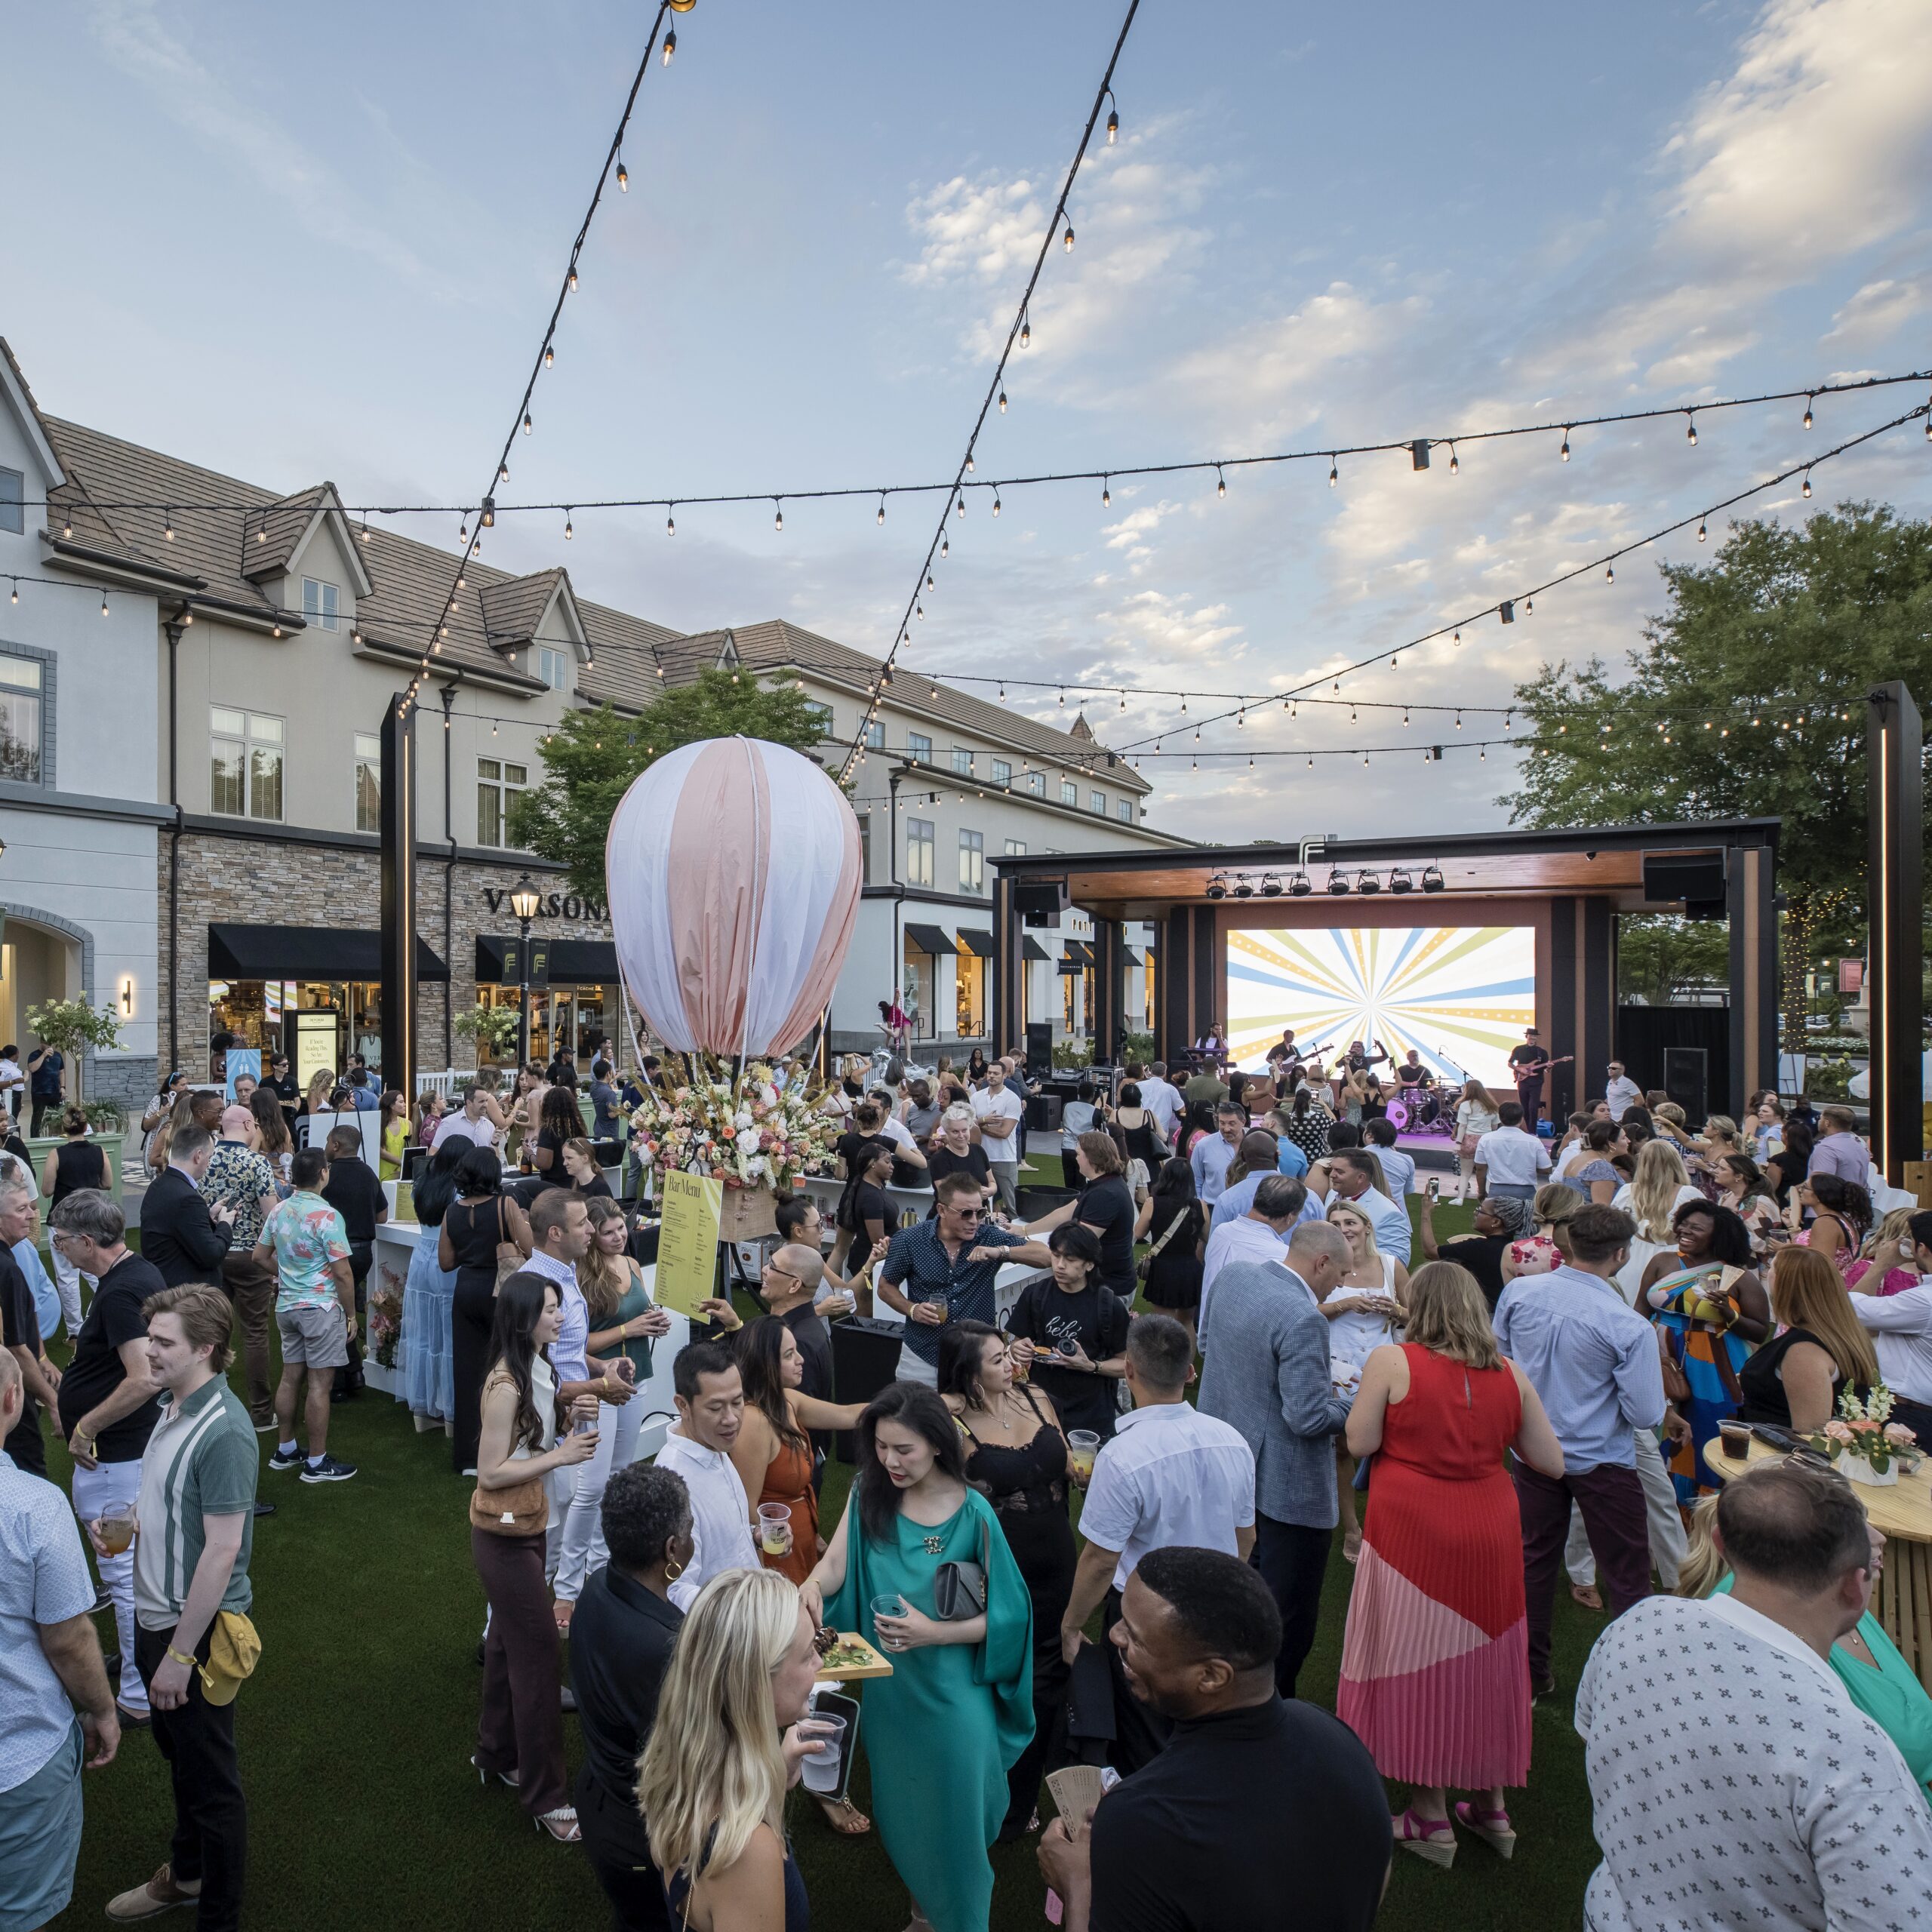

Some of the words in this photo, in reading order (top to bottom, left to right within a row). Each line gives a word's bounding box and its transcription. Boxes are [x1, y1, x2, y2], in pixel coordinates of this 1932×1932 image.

[484, 888, 611, 921] VRSON
[1072, 918, 1092, 932] POTT
[669, 1175, 680, 1192] Bar
[681, 1179, 700, 1198] Menu
